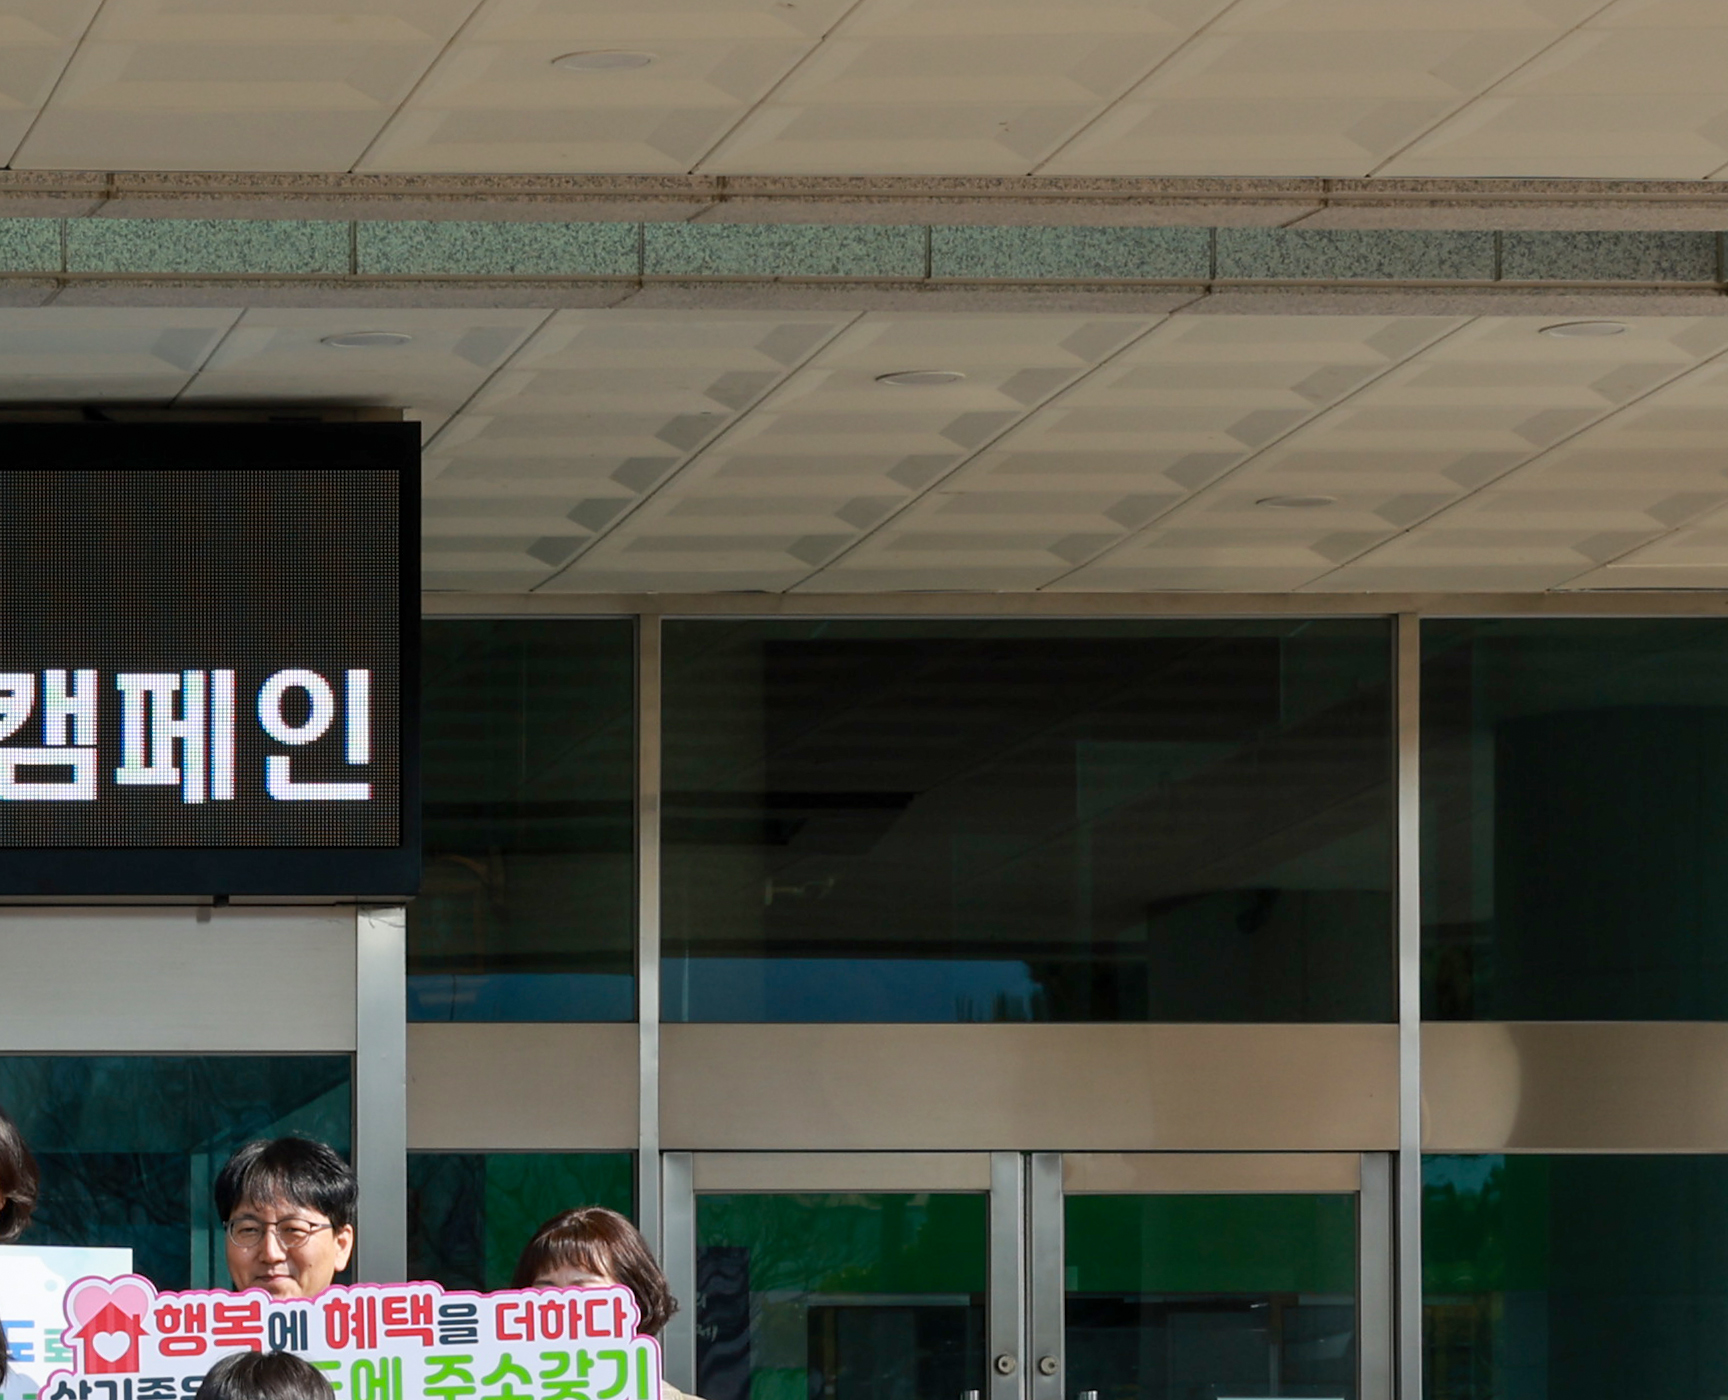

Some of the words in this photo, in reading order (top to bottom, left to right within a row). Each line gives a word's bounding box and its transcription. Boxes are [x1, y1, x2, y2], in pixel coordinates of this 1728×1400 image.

[154, 1300, 309, 1357] 행복에
[323, 1294, 480, 1351] 혜택을
[495, 1297, 628, 1343] 더하다
